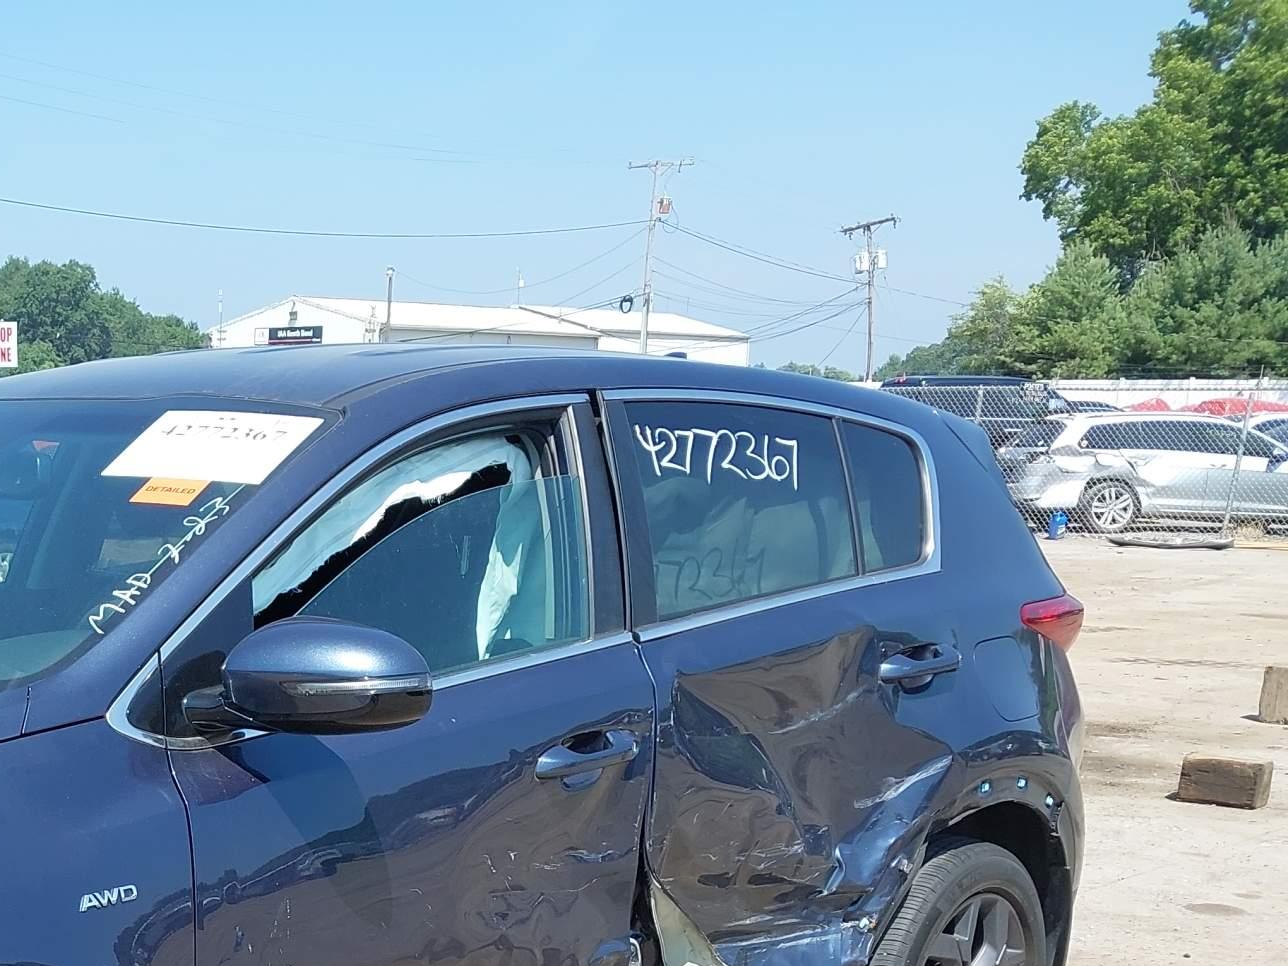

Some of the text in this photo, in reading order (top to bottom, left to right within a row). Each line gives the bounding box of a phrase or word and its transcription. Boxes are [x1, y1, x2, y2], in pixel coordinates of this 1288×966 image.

[634, 423, 798, 491] 42772367
[144, 485, 197, 495] DETAILED
[79, 884, 138, 913] AWD
